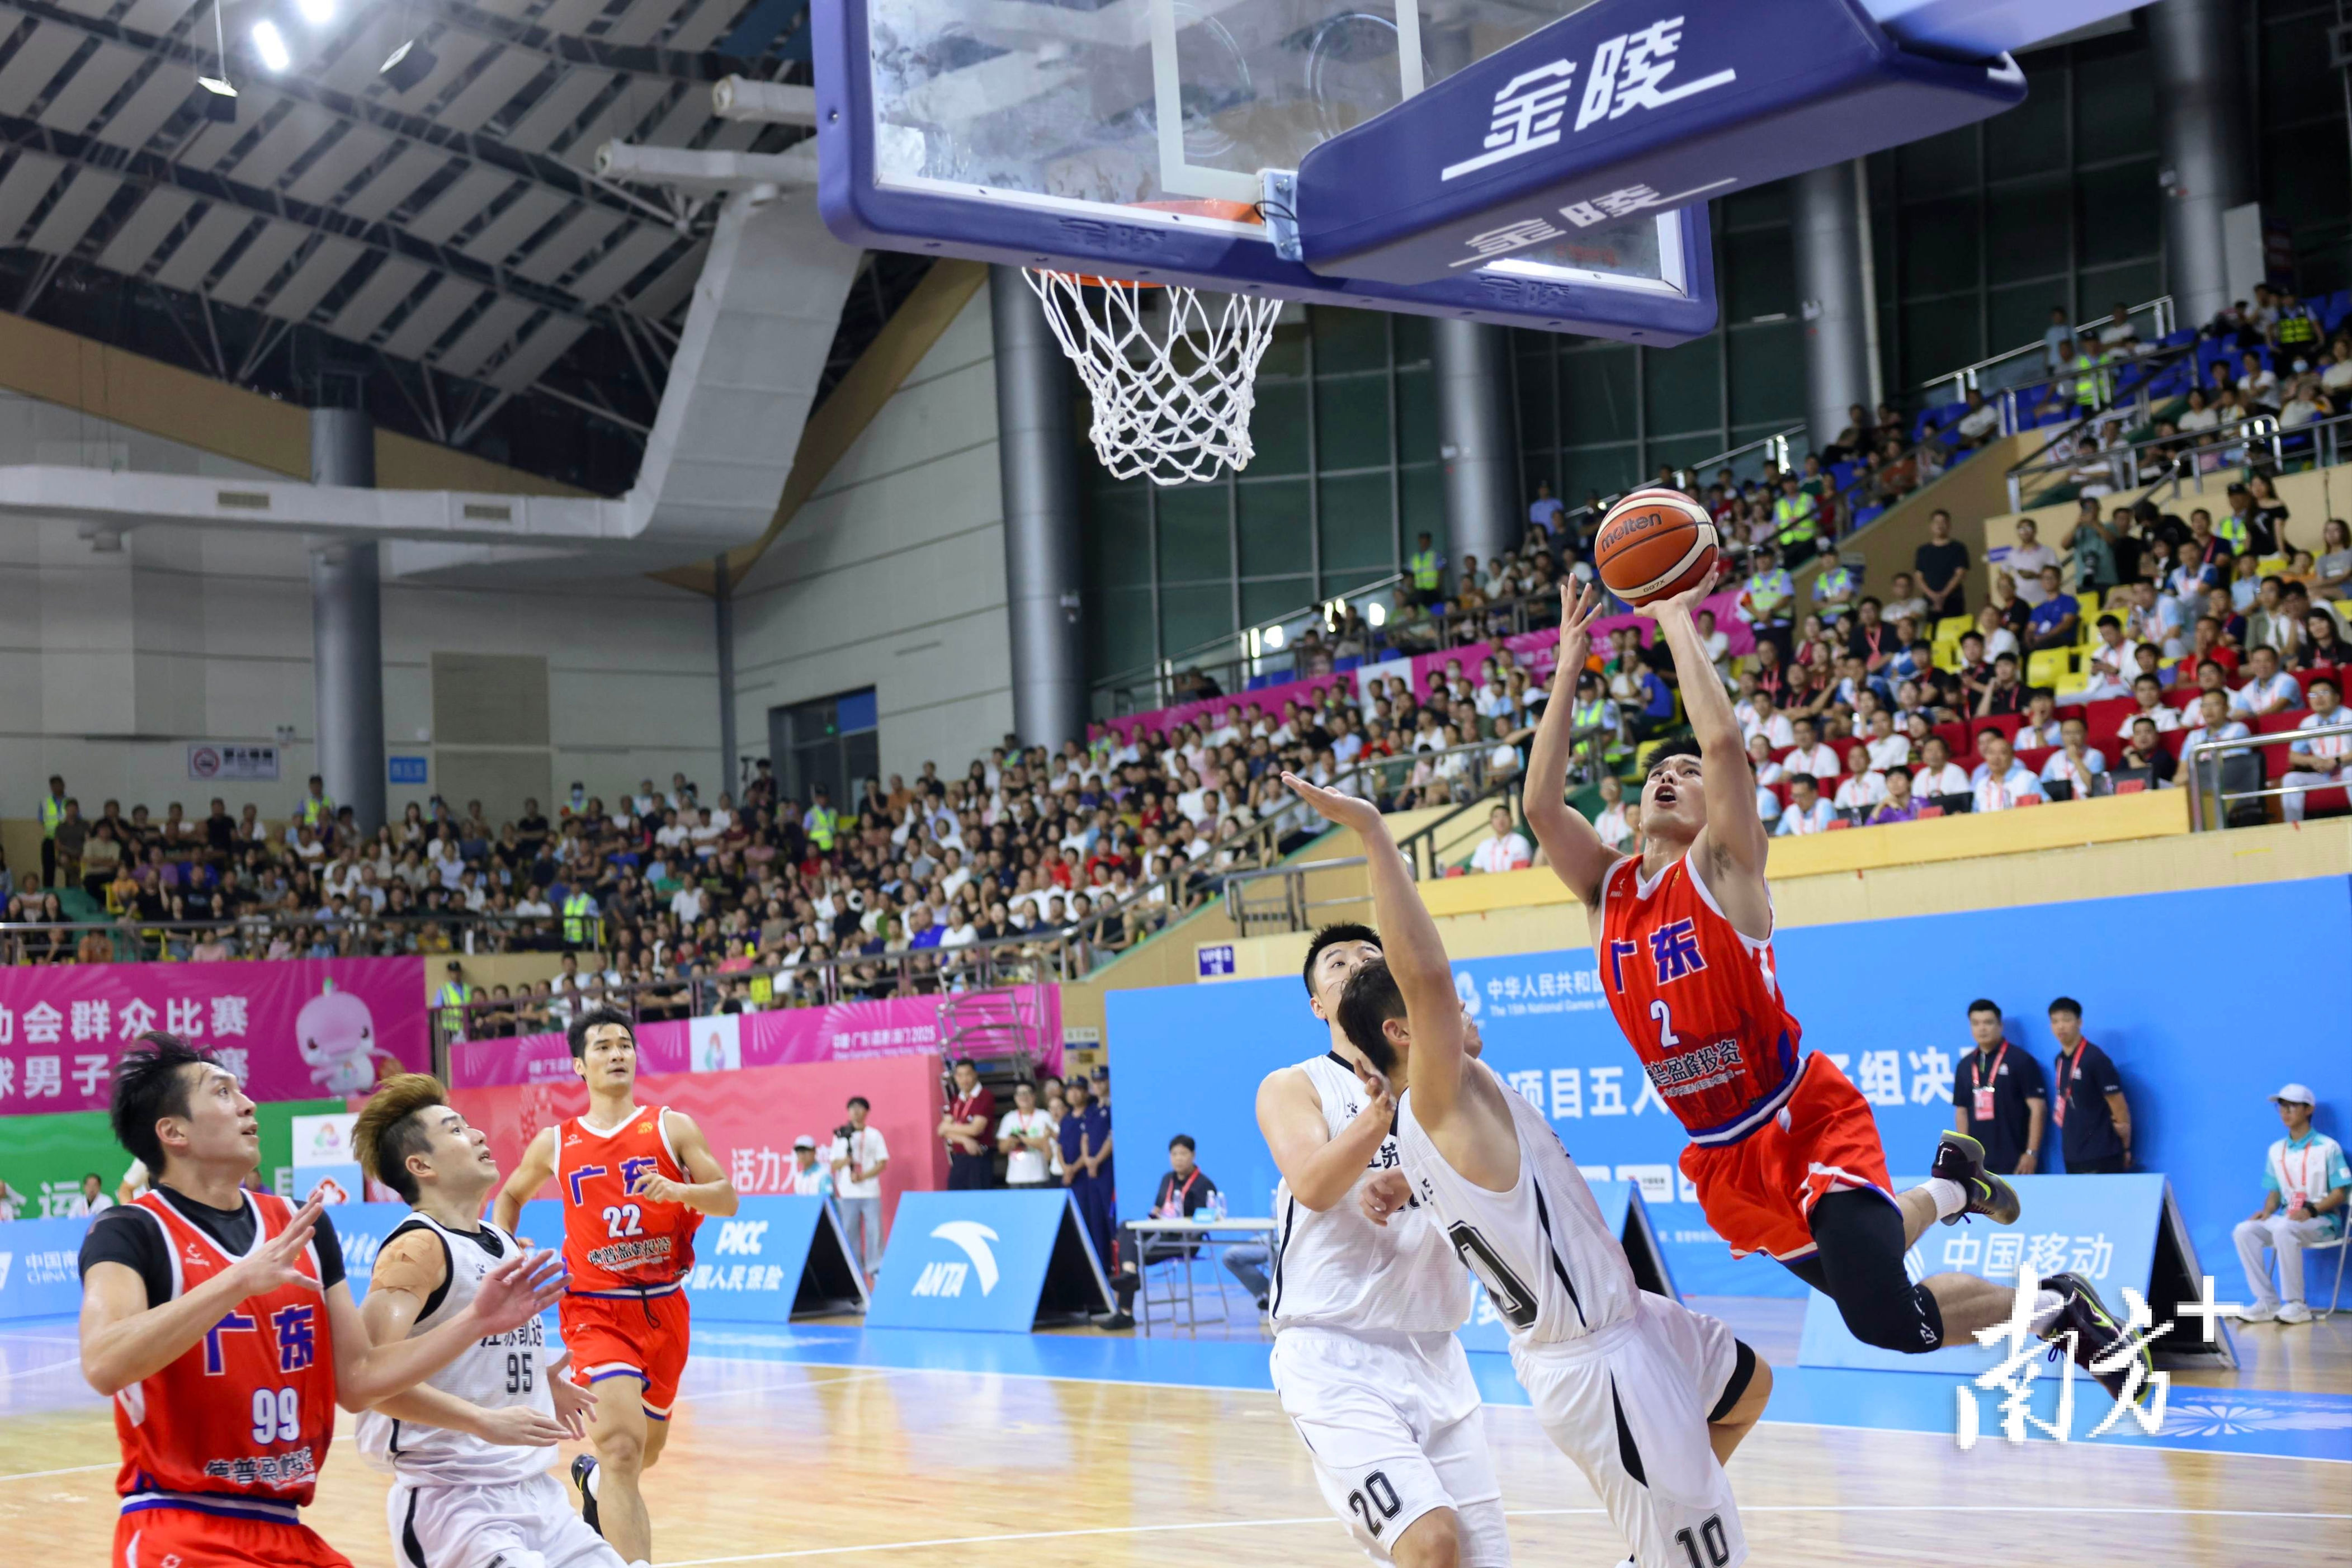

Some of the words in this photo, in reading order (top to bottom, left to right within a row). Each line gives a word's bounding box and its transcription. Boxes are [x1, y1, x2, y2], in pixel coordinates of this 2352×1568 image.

[1442, 16, 1736, 181] 金陵
[1602, 512, 1662, 552] molten
[1610, 917, 1707, 993] 广东
[1650, 999, 1679, 1048] 2
[558, 1156, 659, 1208] 广东
[602, 1203, 643, 1239] 22
[715, 1220, 768, 1255] PICC
[911, 1263, 968, 1297] ANTA
[1943, 1232, 2113, 1281] 中国移动
[204, 1304, 314, 1376] 广东
[506, 1351, 532, 1395] 95
[252, 1386, 300, 1444] 99
[1348, 1469, 1403, 1539] 20
[1675, 1513, 1730, 1568] 10
